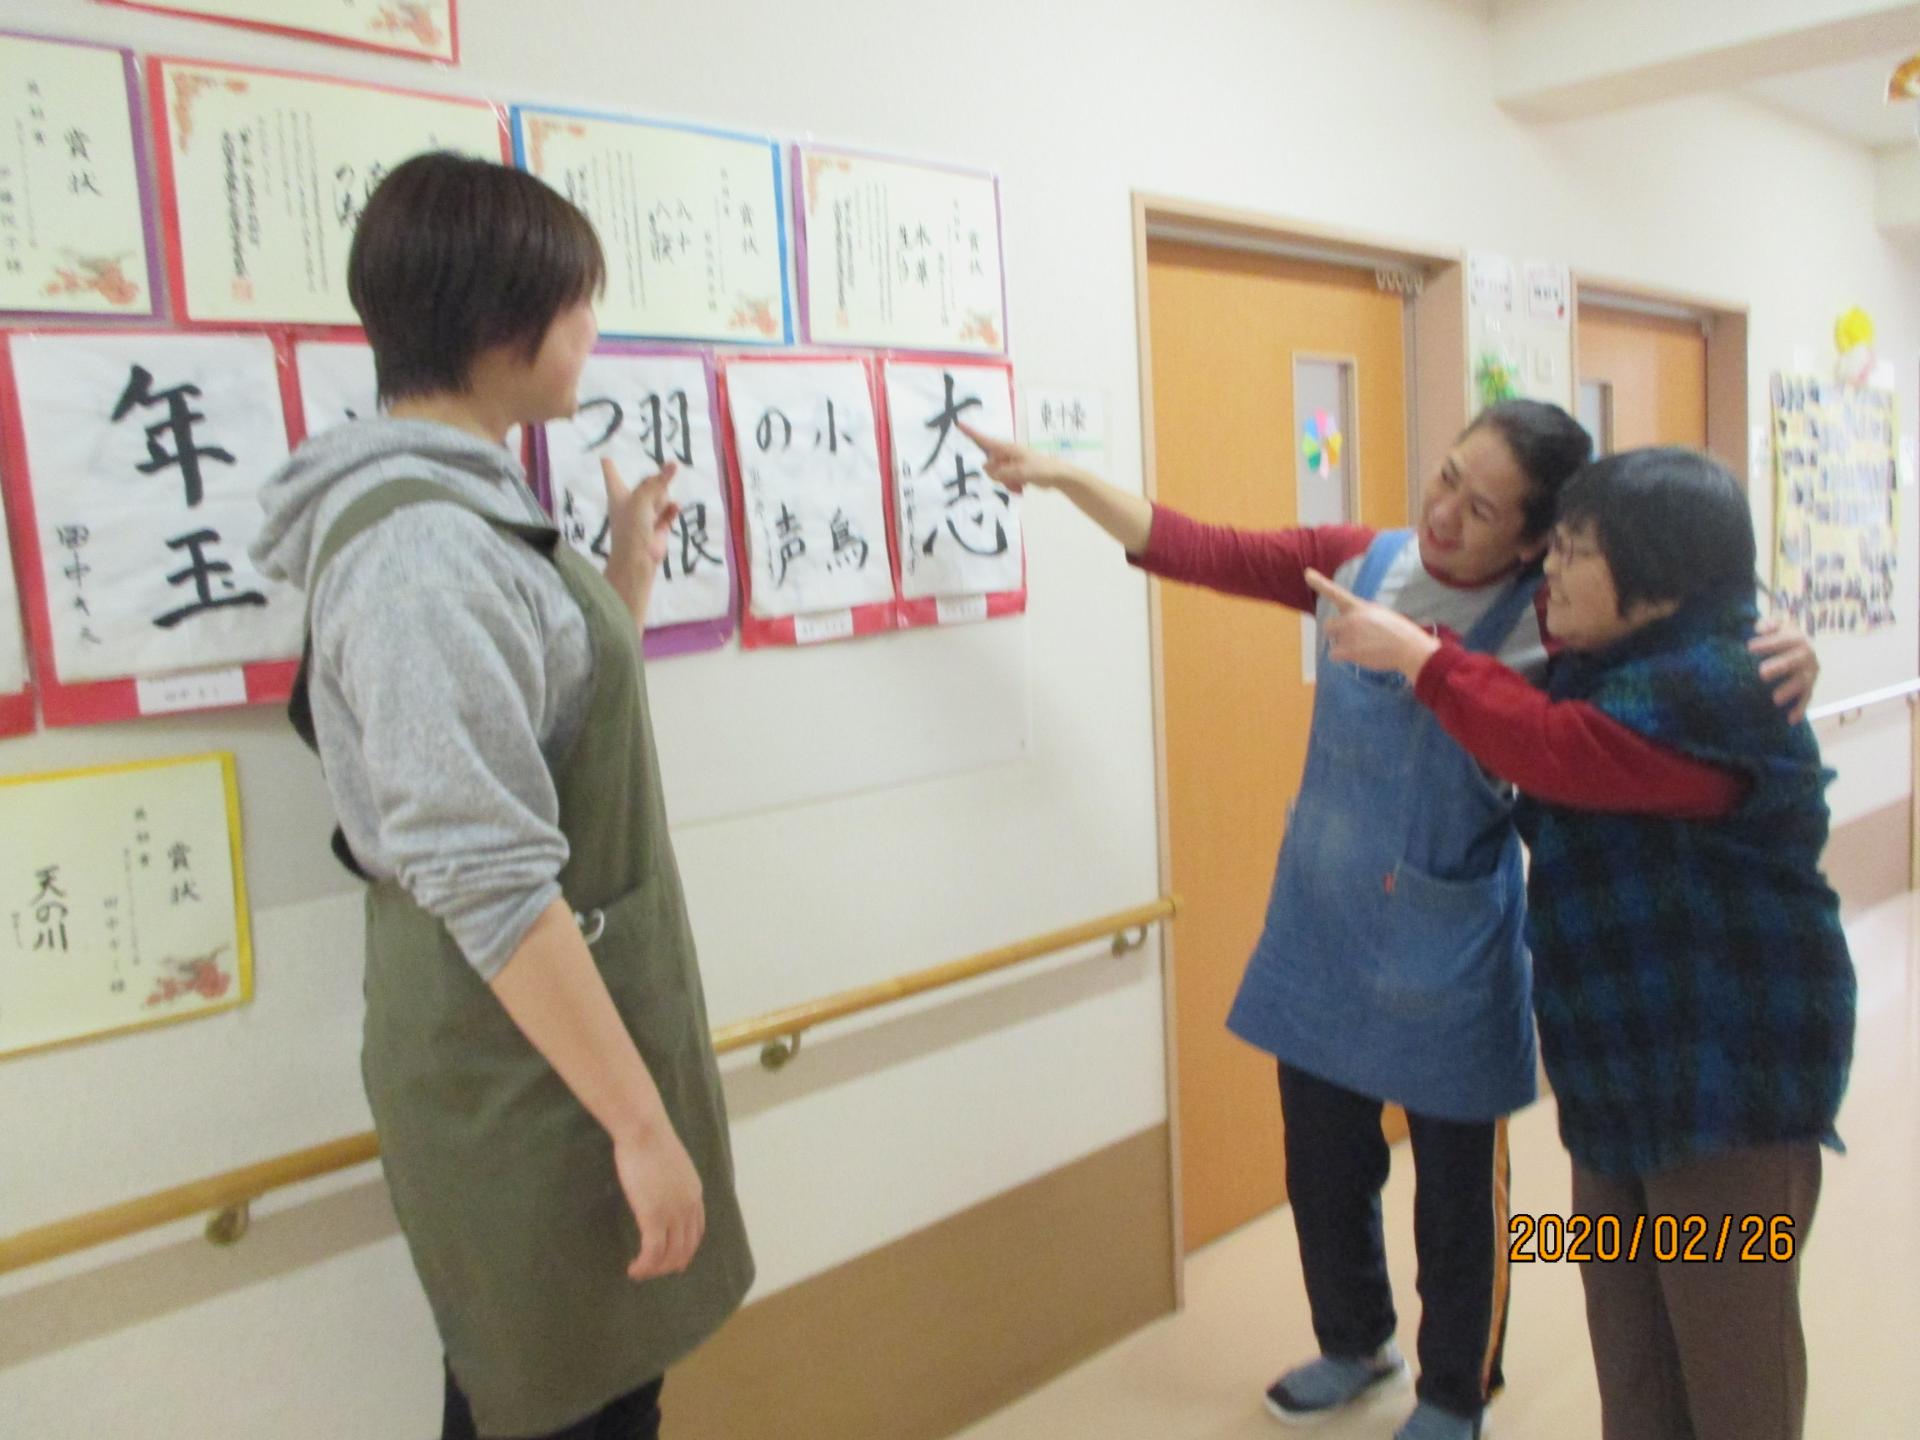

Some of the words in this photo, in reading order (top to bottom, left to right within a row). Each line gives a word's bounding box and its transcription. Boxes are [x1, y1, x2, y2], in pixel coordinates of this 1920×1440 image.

[111, 363, 268, 629] 年玉
[756, 407, 806, 590] の声
[813, 397, 869, 574] 小鳥
[921, 372, 1010, 557] 大志
[32, 864, 69, 952] 天の川
